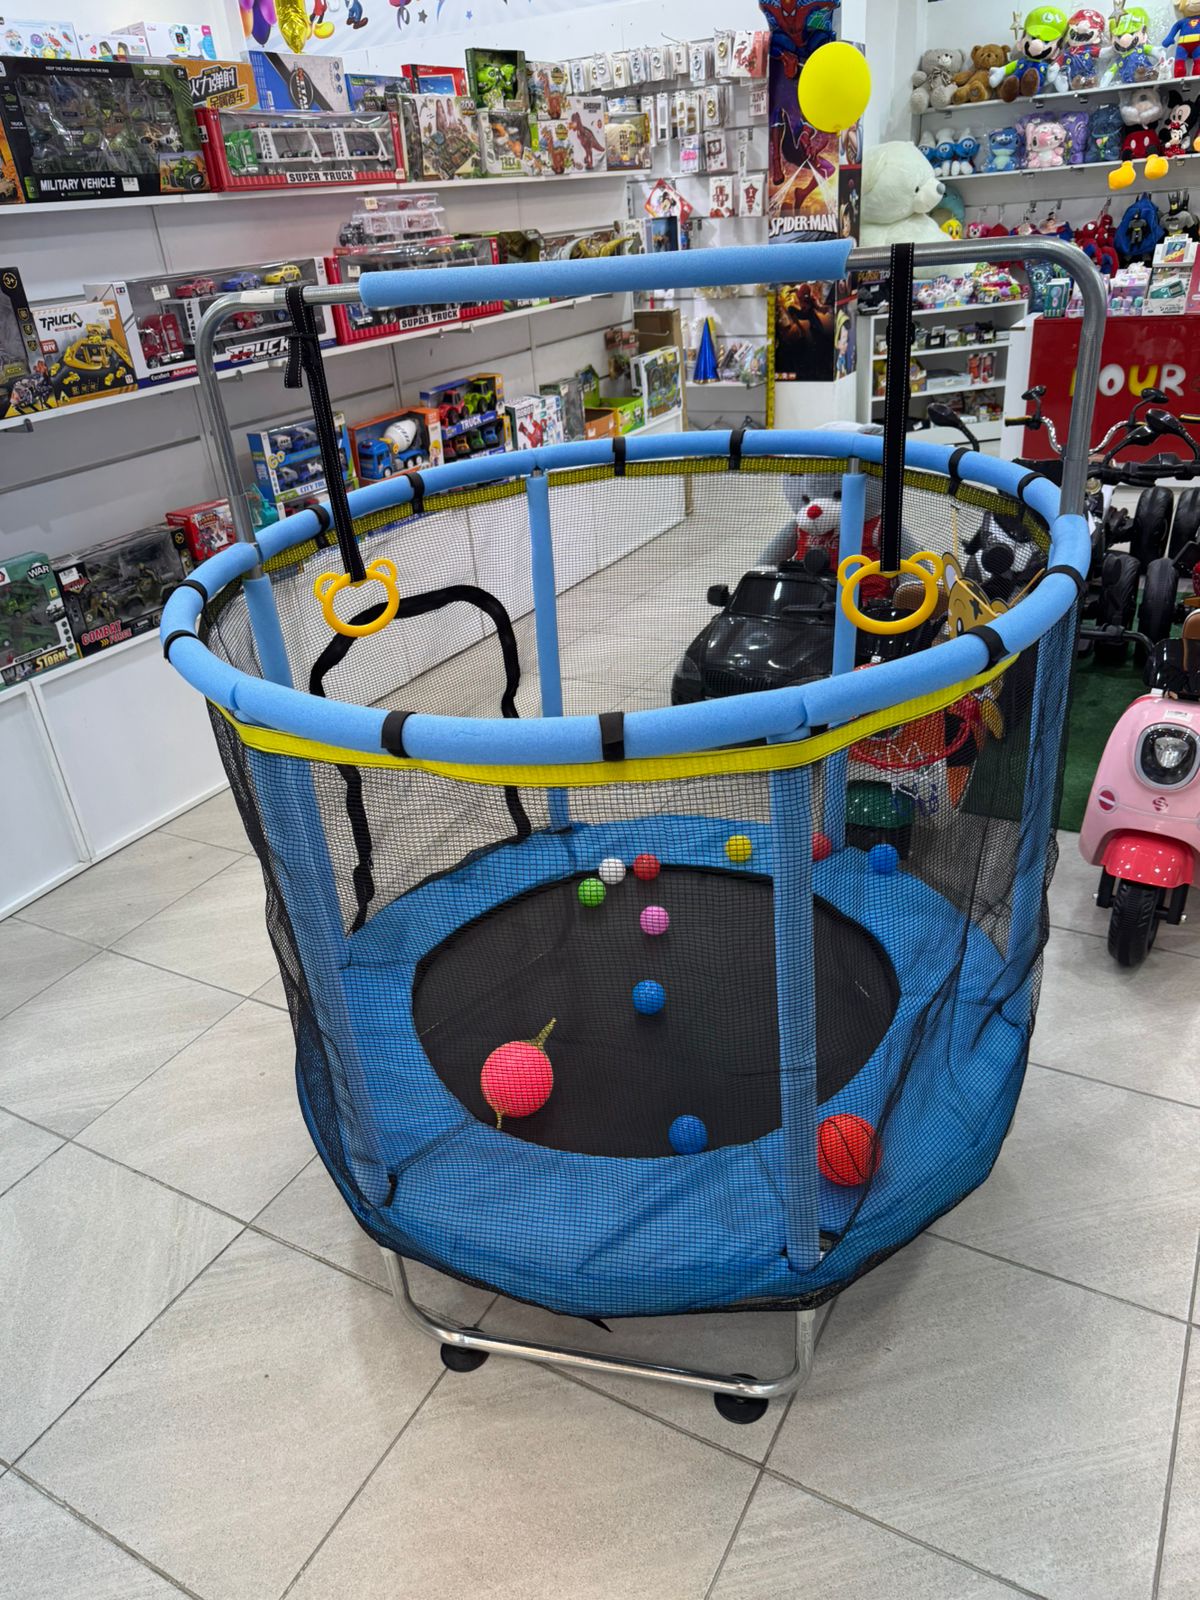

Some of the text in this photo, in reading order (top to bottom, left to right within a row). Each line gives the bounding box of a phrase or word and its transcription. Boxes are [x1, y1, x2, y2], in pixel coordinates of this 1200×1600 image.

[40, 177, 116, 191] MILITARY VEHICLE
[288, 170, 354, 183] SUPER TRUCK
[769, 213, 838, 236] SPIDER-MAN
[401, 310, 459, 328] SUPER TRUCK
[43, 342, 56, 352] DIY
[1069, 363, 1186, 397] OUR
[461, 414, 482, 430] TRUCK
[28, 565, 50, 578] WAR
[81, 620, 122, 646] COMBAT
[36, 649, 68, 671] STORM
